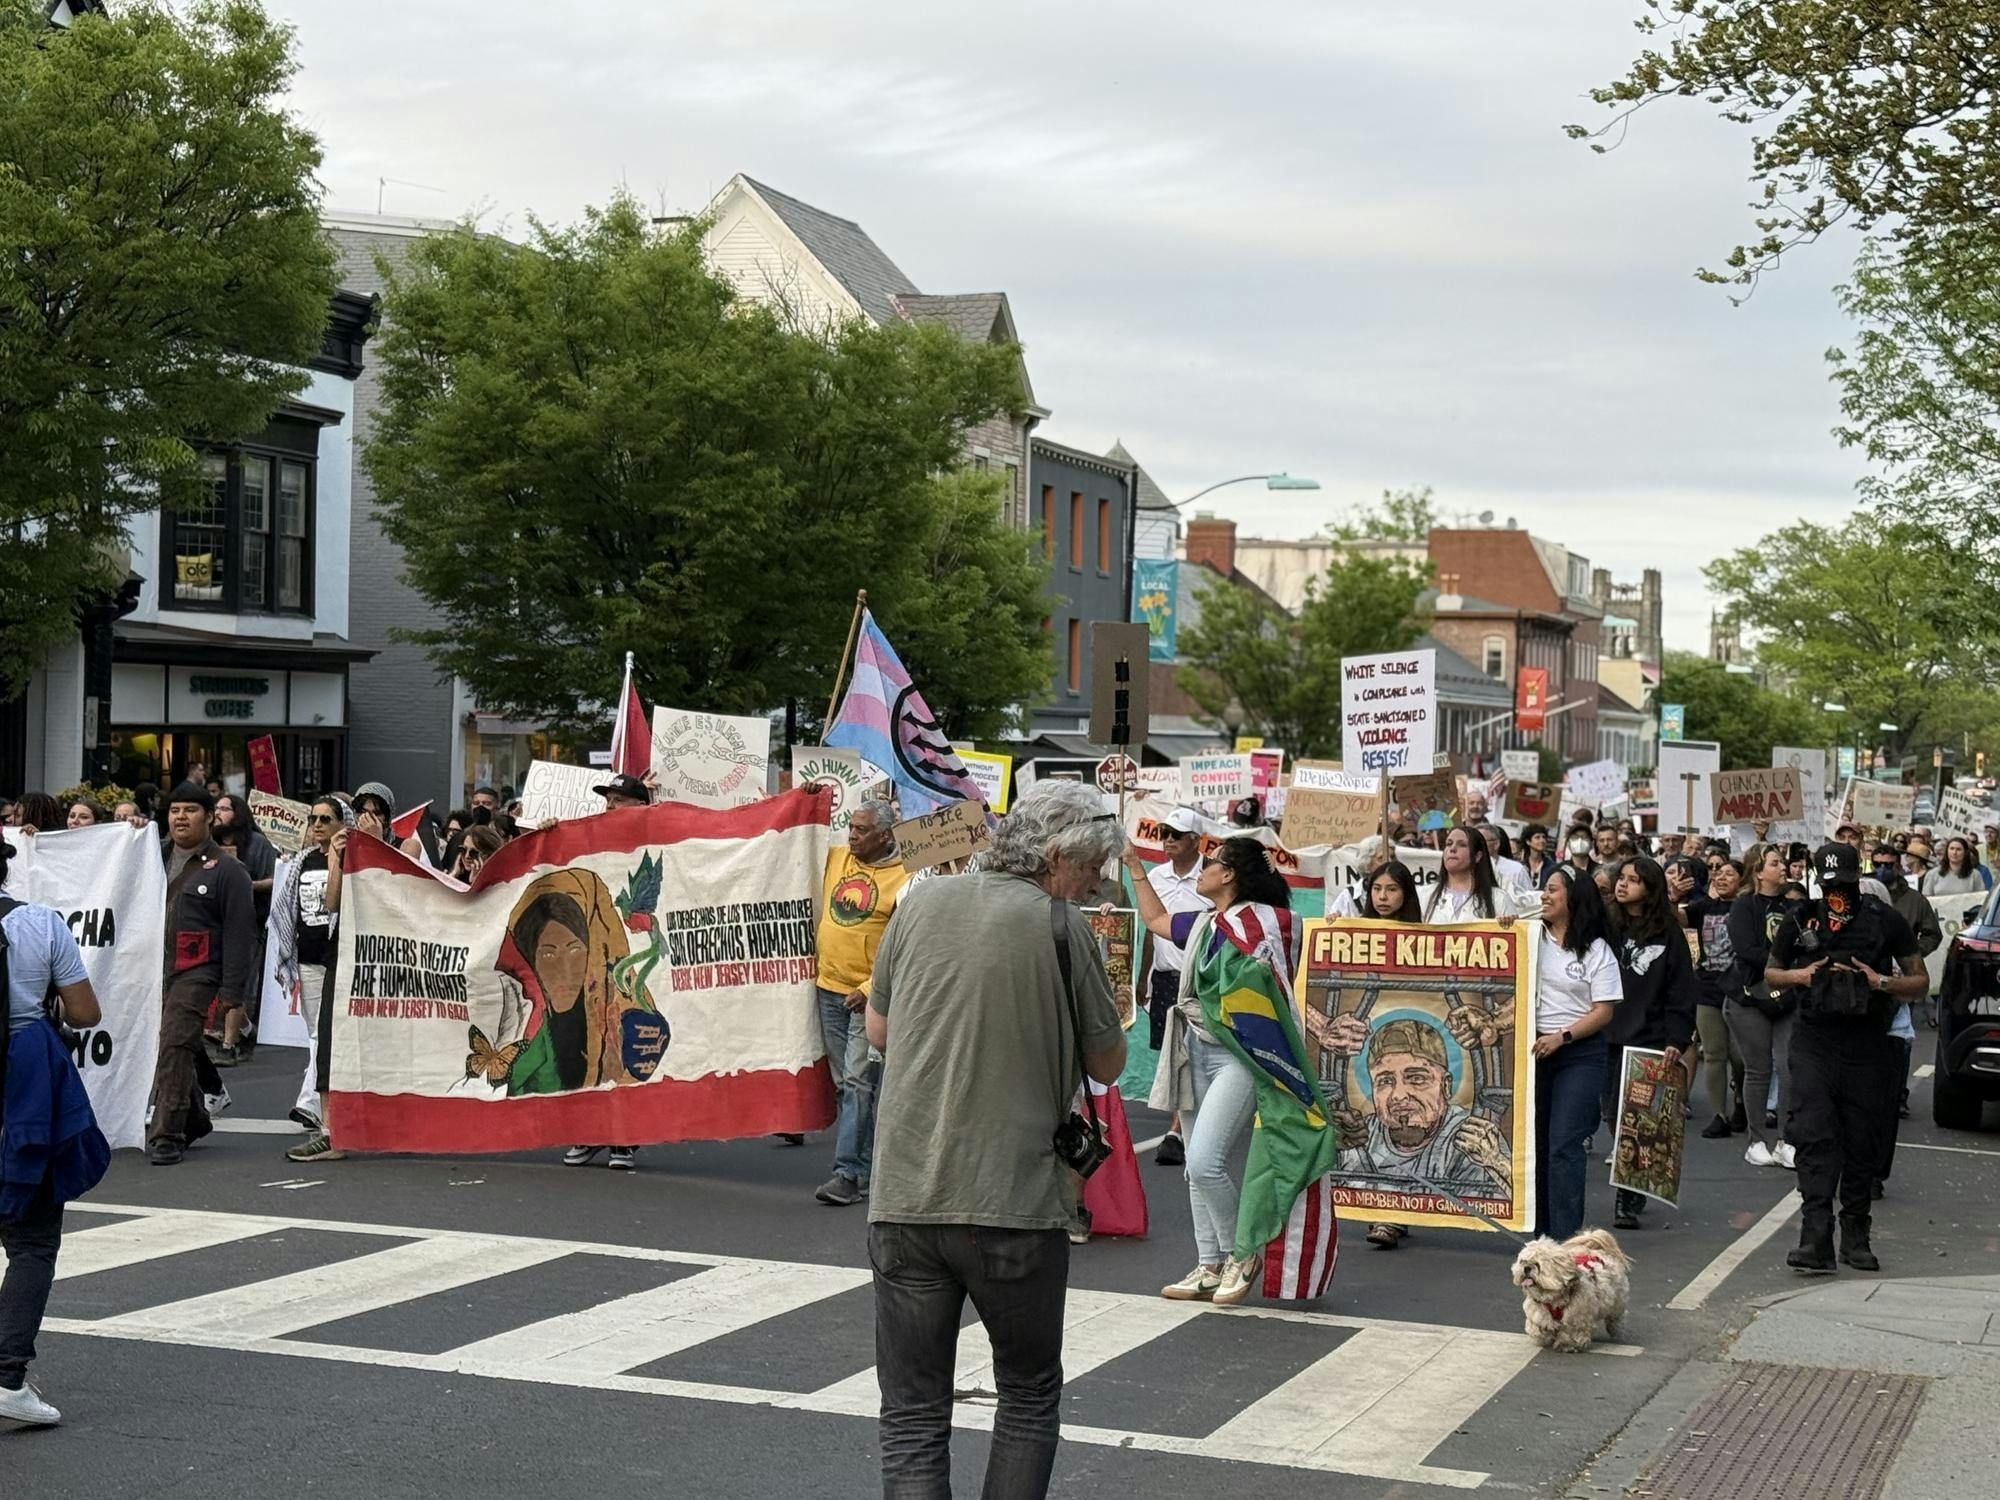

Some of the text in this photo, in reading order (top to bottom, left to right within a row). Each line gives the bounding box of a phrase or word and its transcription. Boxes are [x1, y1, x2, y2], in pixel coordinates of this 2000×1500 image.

[1141, 581, 1170, 591] LOCAL
[1345, 661, 1419, 680] WHITE SILENCE
[1362, 686, 1407, 701] COMPLIANCE
[1410, 685, 1425, 696] with
[205, 699, 254, 718] COFFEE
[696, 715, 713, 730] ES
[965, 763, 994, 773] WITHOUT
[1191, 759, 1241, 771] IMPEACH
[1362, 747, 1409, 771] RESIST!
[799, 760, 819, 783] NO
[822, 758, 861, 787] HUMAN
[971, 772, 1000, 783] PROCESS
[1191, 772, 1242, 784] CONVICT
[1193, 784, 1241, 797] REMOVE!
[1720, 772, 1794, 794] CHINGA LA
[1716, 791, 1793, 820] MIGRA!
[1944, 790, 1977, 807] BRING
[1304, 816, 1333, 825] Stand
[1335, 817, 1349, 829] Up
[1937, 817, 1969, 835] HOME
[676, 906, 716, 930] DERECHOS
[716, 905, 726, 925] DE
[727, 903, 742, 924] LOS
[668, 919, 816, 966] SON DERECHOS HUMANOS
[1314, 931, 1509, 969] FREE KILMAR
[355, 934, 469, 973] WORKERS RIGHTS
[350, 965, 468, 1003] ARE HUMAN RIGHTS
[693, 965, 713, 990] NEW
[715, 962, 751, 987] JERSEY
[752, 960, 789, 984] HASTA
[348, 998, 469, 1022] FROM NEW JERSEY TO GAZA
[1355, 1190, 1400, 1208] MEMBER
[1401, 1195, 1425, 1210] NOT
[1427, 1198, 1435, 1211] A
